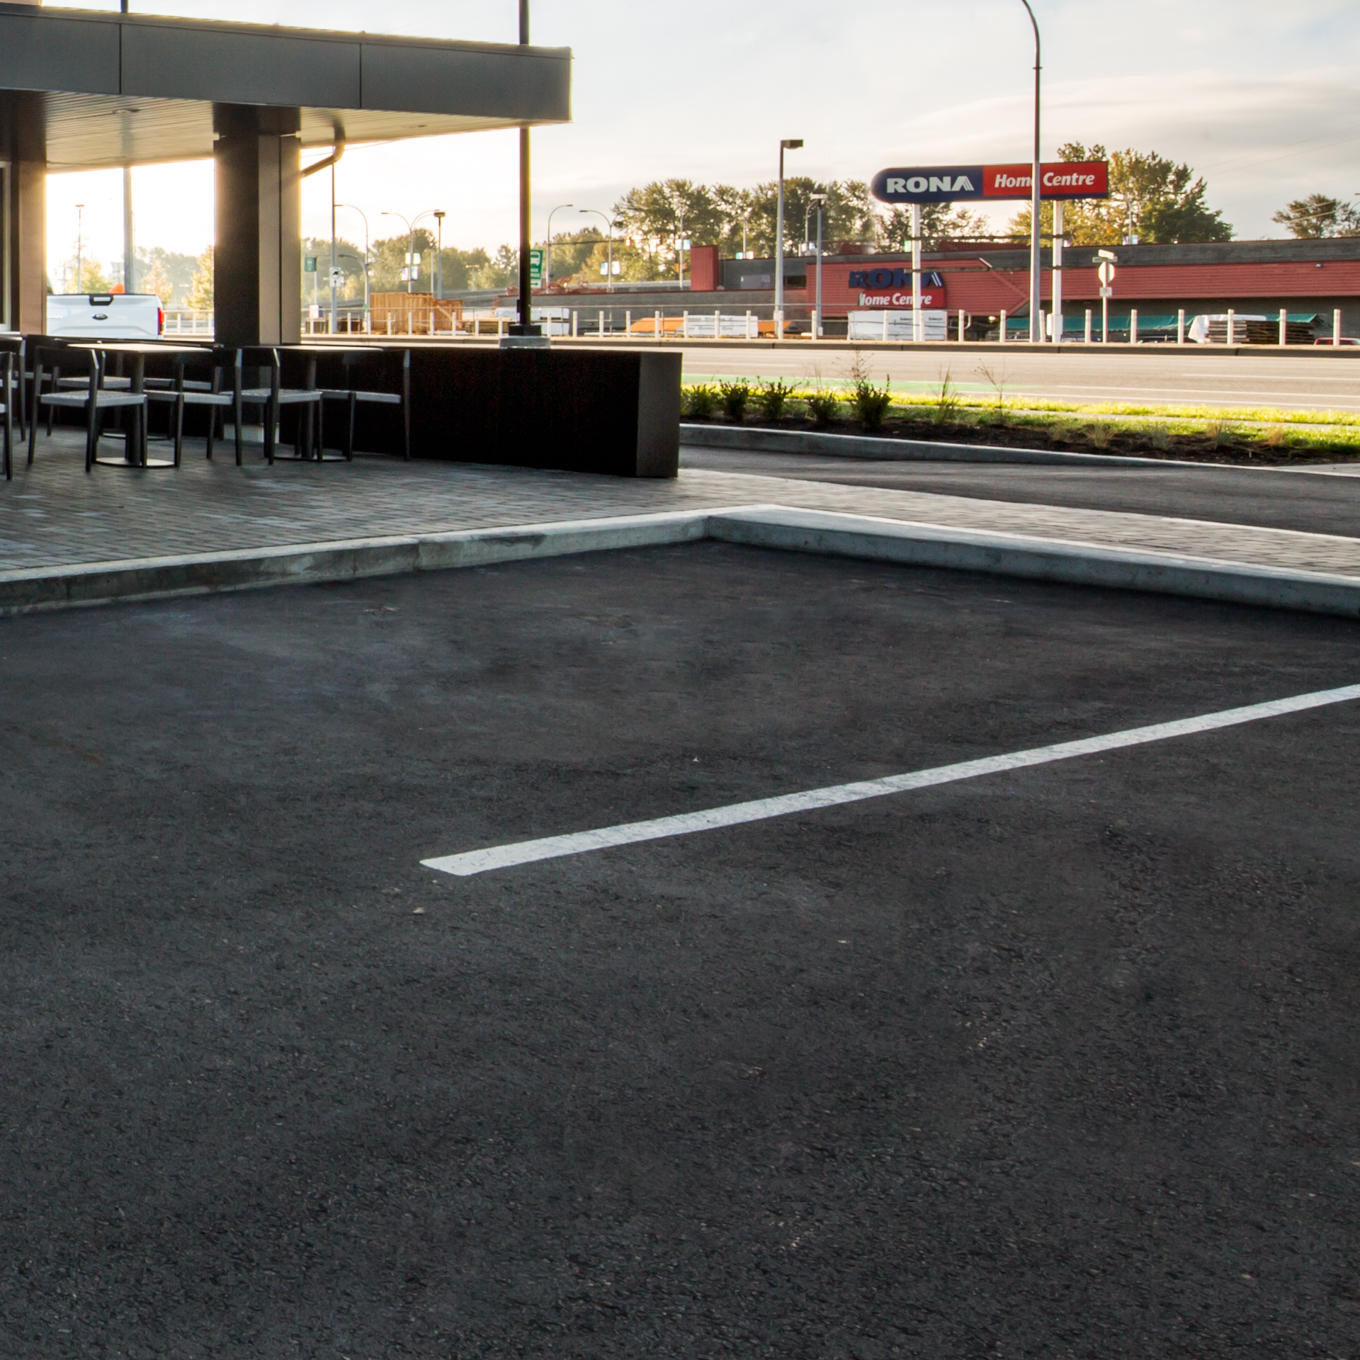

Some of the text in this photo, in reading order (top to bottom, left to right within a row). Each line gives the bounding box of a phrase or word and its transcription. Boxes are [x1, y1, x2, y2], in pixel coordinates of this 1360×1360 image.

[886, 175, 974, 193] RONA
[1043, 172, 1095, 187] Centre
[849, 268, 944, 288] RONA
[892, 293, 932, 306] Cenre
